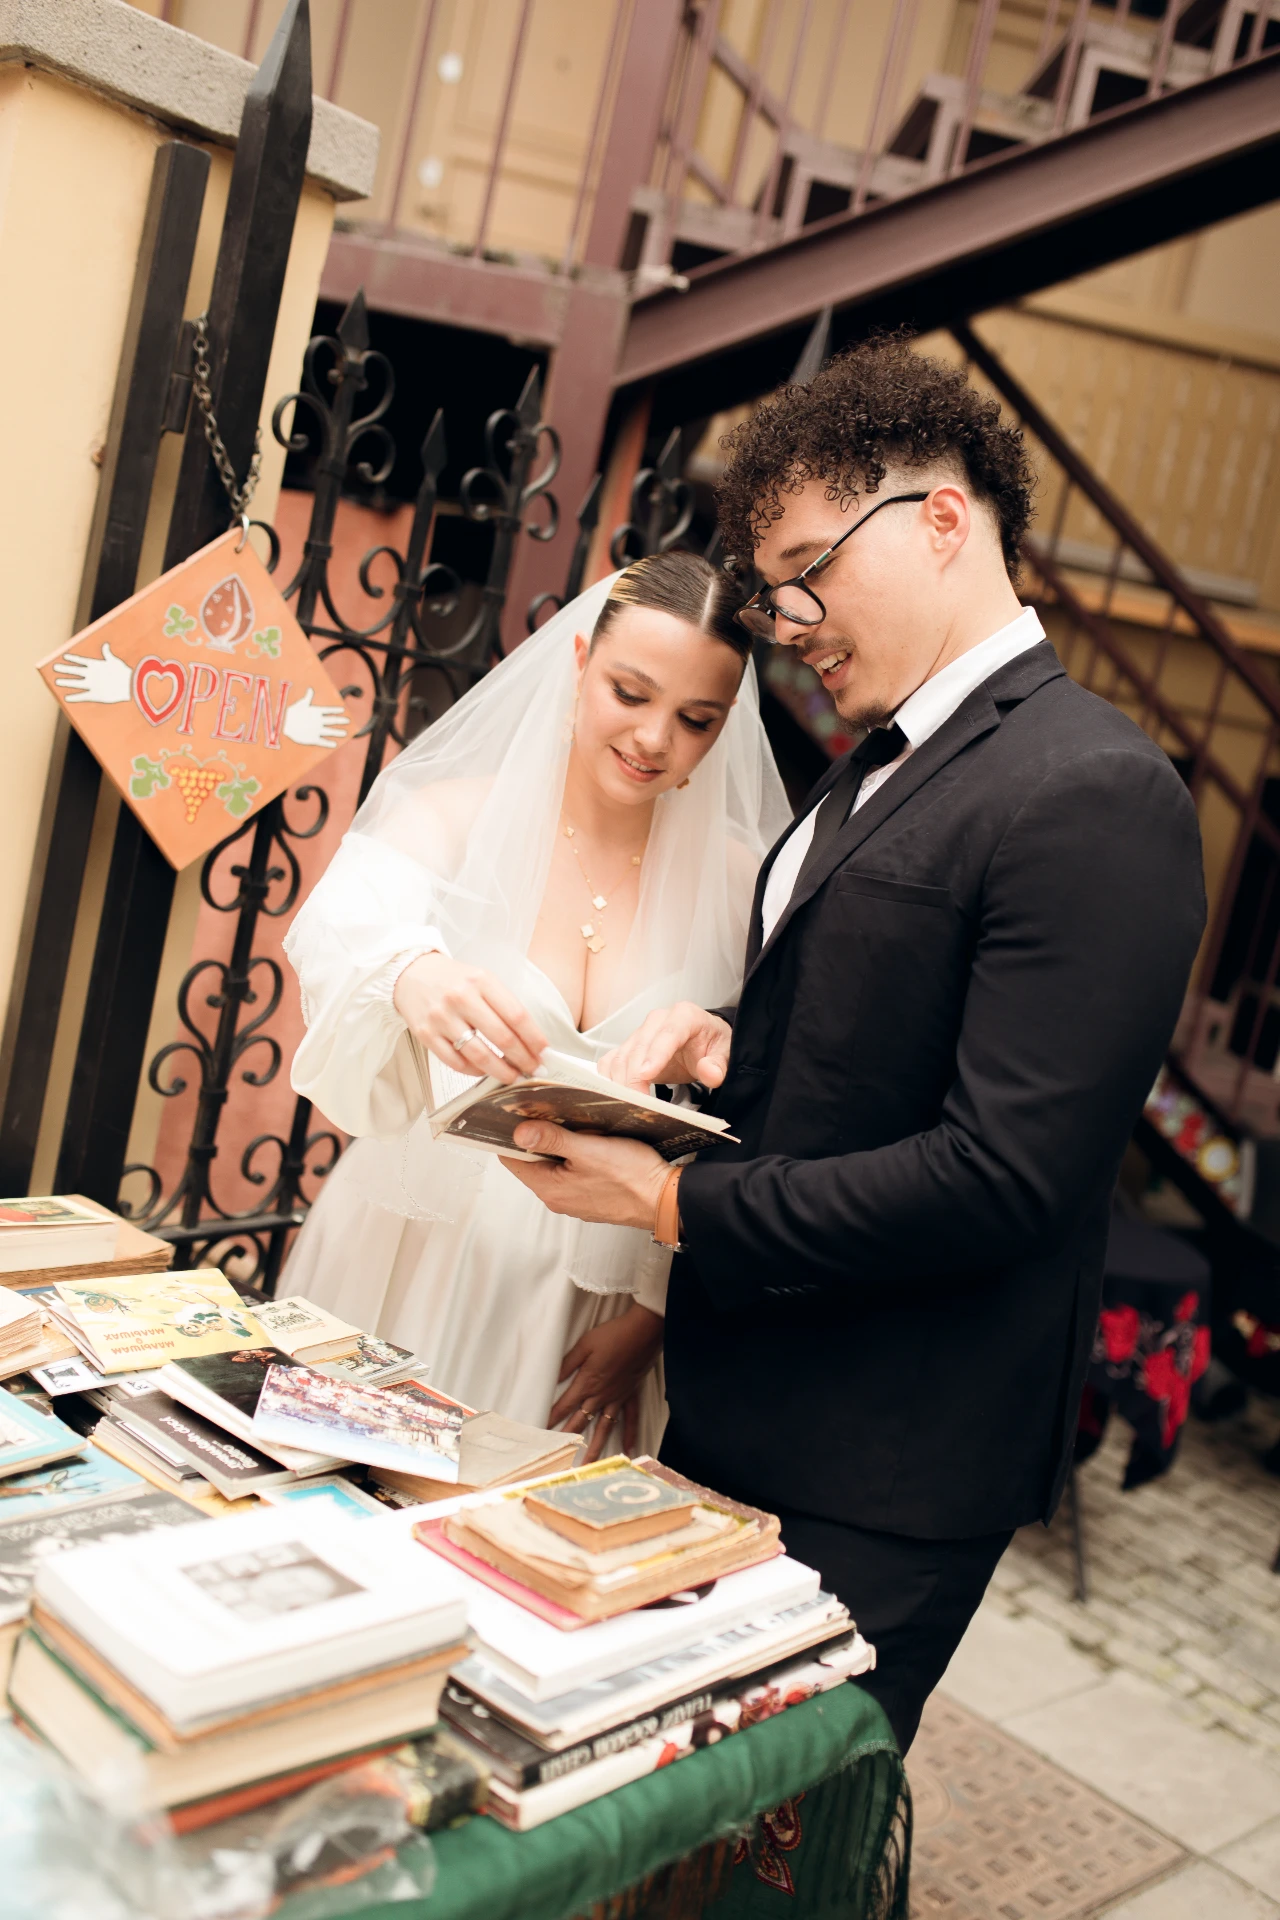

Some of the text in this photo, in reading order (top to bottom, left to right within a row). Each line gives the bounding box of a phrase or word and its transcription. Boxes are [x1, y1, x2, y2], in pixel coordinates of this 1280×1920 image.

[133, 655, 290, 748] OPEN
[103, 1328, 164, 1340] МАЛЫШАХ
[111, 1341, 174, 1354] МАЛЫШАМ
